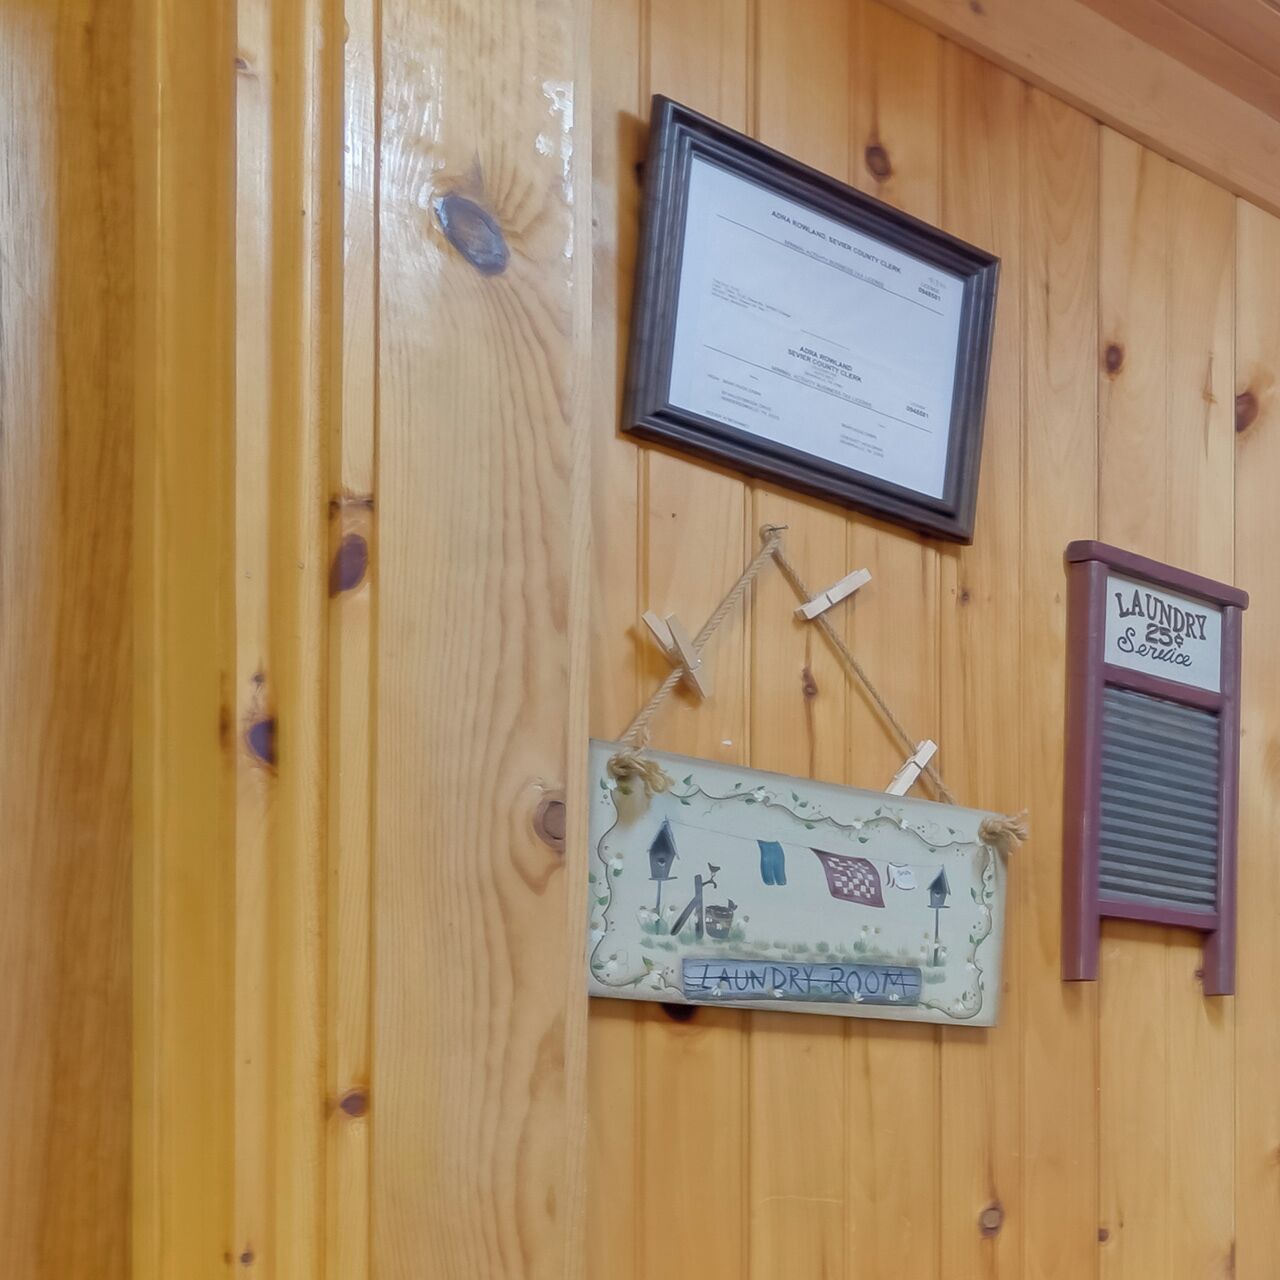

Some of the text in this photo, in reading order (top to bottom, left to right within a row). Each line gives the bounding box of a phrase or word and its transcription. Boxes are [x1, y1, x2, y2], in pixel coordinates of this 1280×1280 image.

[828, 236, 852, 252] SEVIER
[853, 246, 880, 262] COUNTY
[880, 259, 901, 274] CLERK
[788, 349, 812, 362] SEVIER
[812, 358, 840, 374] COUNTY
[840, 370, 862, 383] CLERK
[1115, 589, 1207, 640] LAUNDRY
[1117, 627, 1192, 667] Service
[1145, 623, 1184, 648] 25¢
[701, 963, 908, 996] LAUNDRY ROOM
